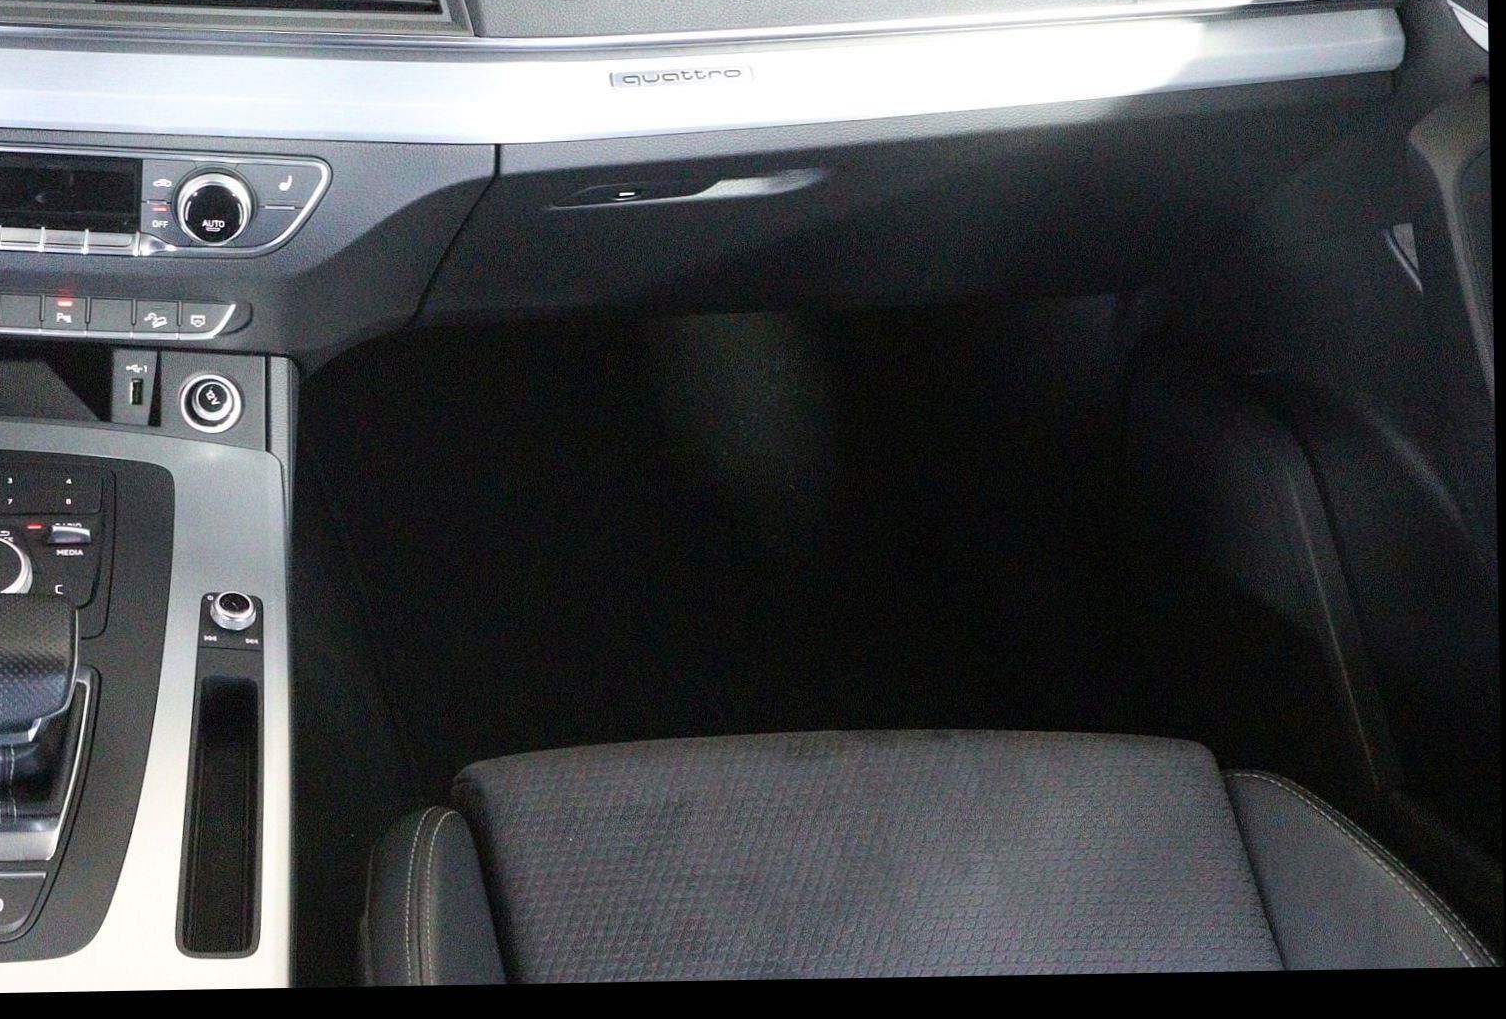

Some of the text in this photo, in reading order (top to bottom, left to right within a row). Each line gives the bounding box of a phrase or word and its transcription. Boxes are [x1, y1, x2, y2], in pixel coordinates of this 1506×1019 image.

[622, 68, 742, 87] quattro
[152, 219, 169, 229] OFF
[201, 218, 226, 229] AUTO
[56, 549, 84, 557] MEDIA
